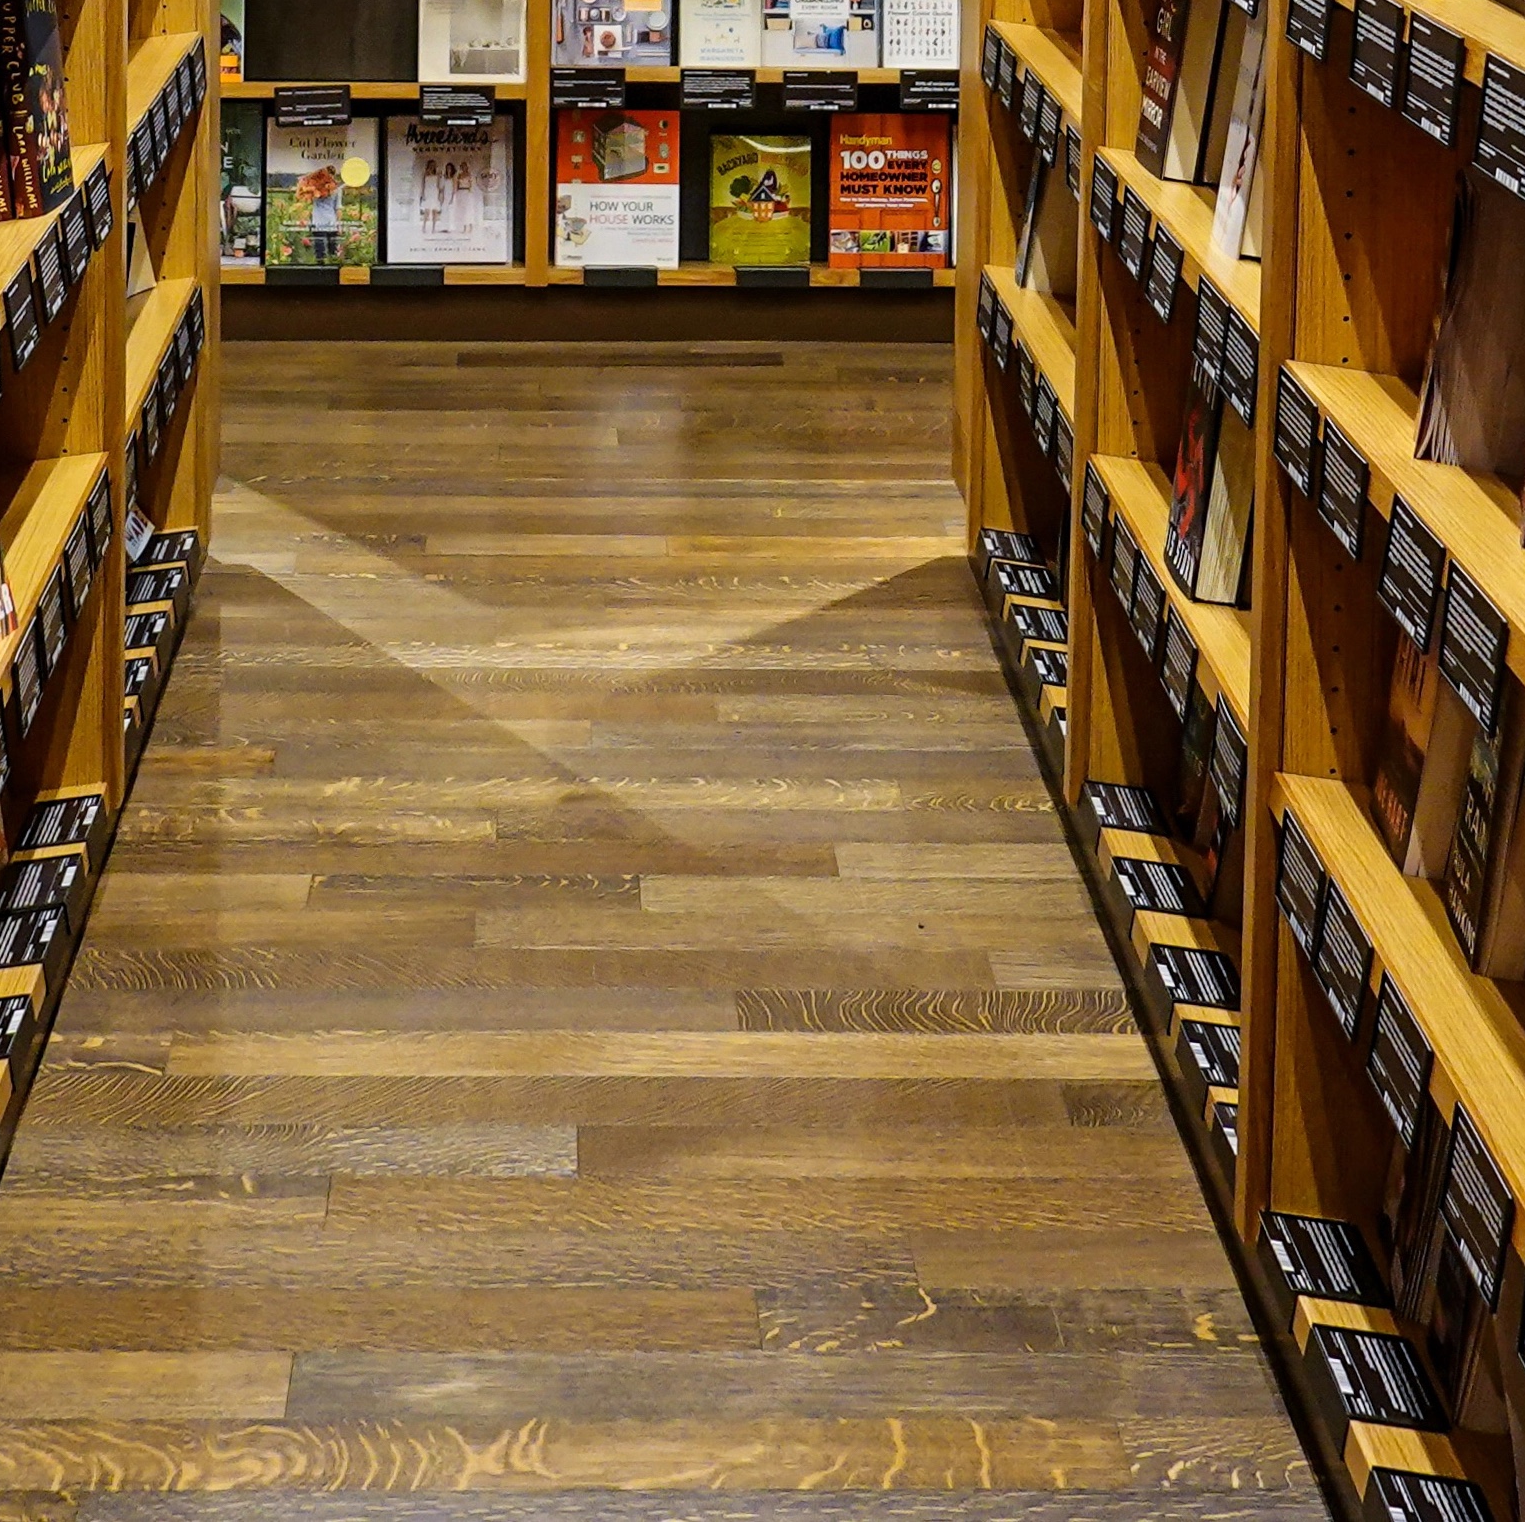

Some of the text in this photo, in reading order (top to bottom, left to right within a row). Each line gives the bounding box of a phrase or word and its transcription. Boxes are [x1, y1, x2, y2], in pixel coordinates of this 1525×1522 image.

[839, 133, 893, 148] Handyman
[839, 150, 928, 171] 100 THINGS
[887, 160, 928, 171] EVERY
[839, 171, 928, 183] HOMEOWNER
[839, 184, 928, 195] MUST KNOW
[589, 201, 654, 213] HOW YOUR
[589, 214, 674, 226] HOUSE WORKS
